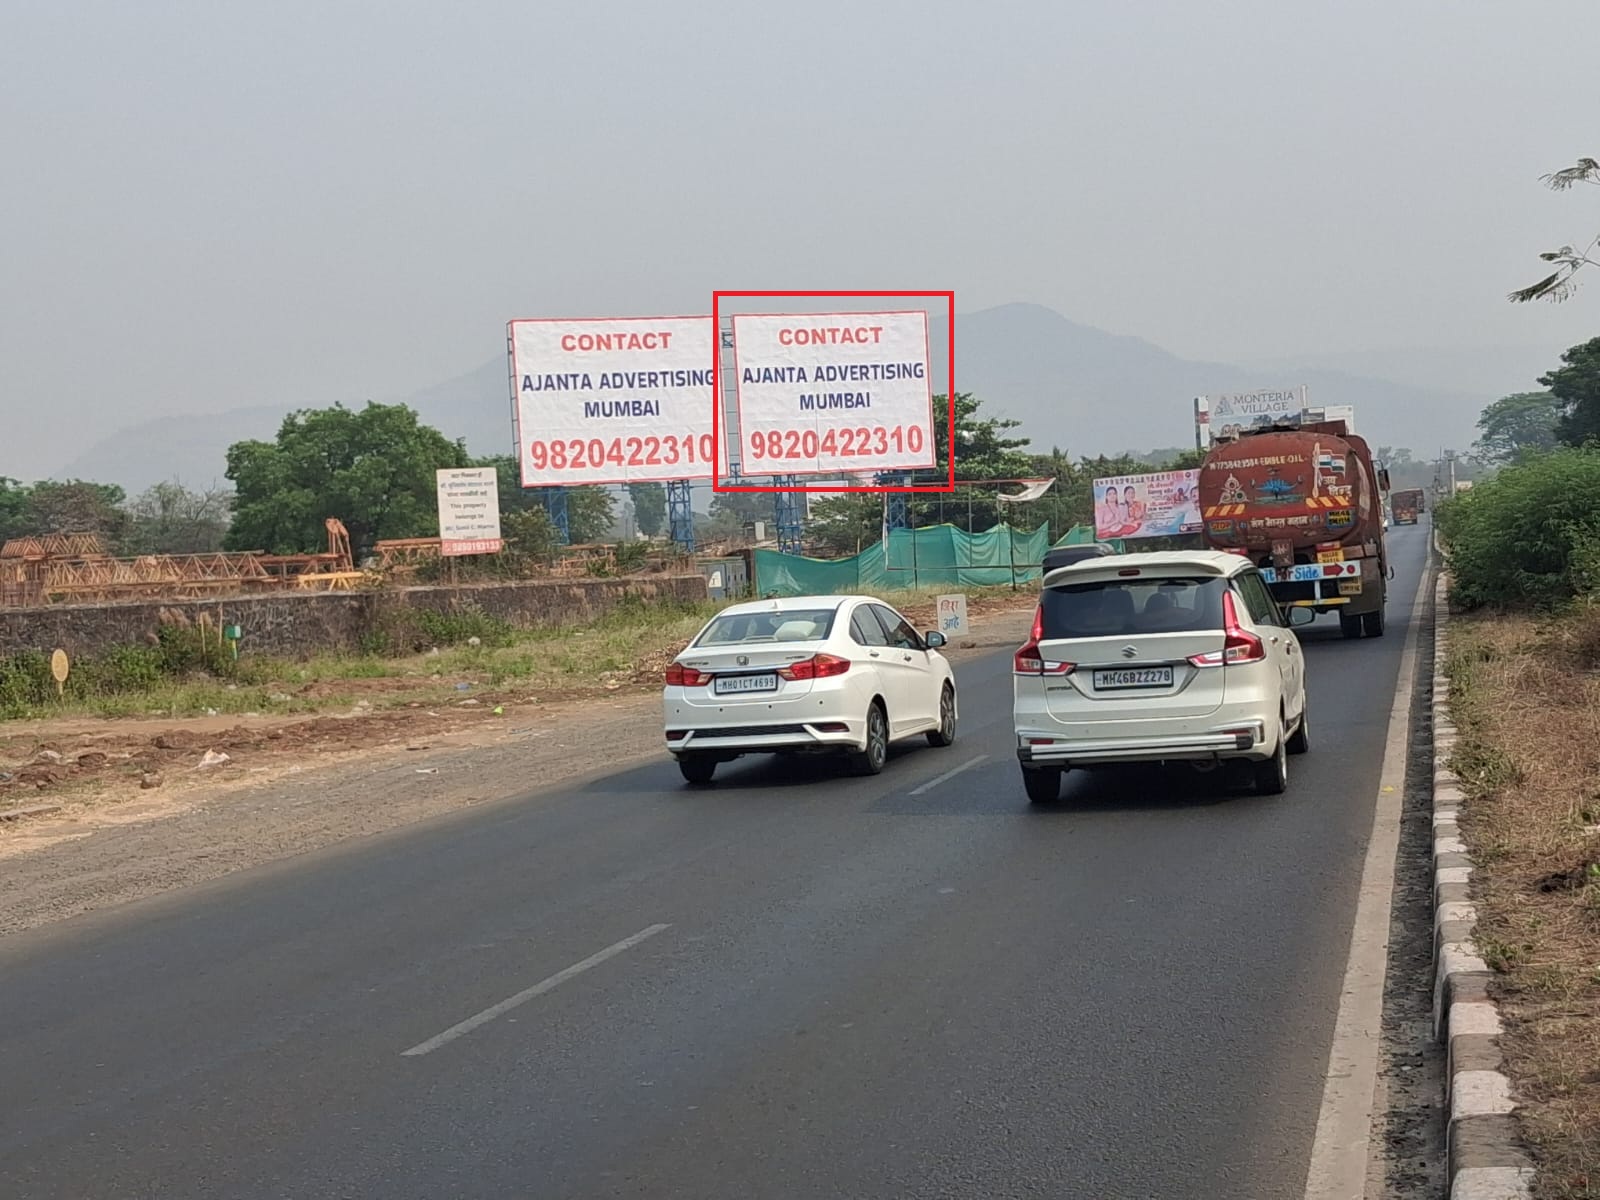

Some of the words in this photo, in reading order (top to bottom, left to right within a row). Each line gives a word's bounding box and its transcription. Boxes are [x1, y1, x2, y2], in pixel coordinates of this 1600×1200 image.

[561, 332, 672, 351] CONTACT
[779, 327, 883, 345] CONTACT
[522, 373, 593, 391] AJANTA
[600, 369, 713, 389] ADVERTISING
[743, 367, 807, 384] AJANTA
[814, 363, 924, 382] ADVERTISING
[800, 392, 871, 410] MUMBAI
[1233, 391, 1294, 405] MONTERIA
[584, 400, 660, 418] MUMBAI
[1241, 402, 1289, 414] VILLAGE
[751, 425, 923, 459] 9820422310
[531, 434, 714, 470] 9820422310
[1287, 454, 1304, 464] OIL
[1294, 564, 1320, 580] Side
